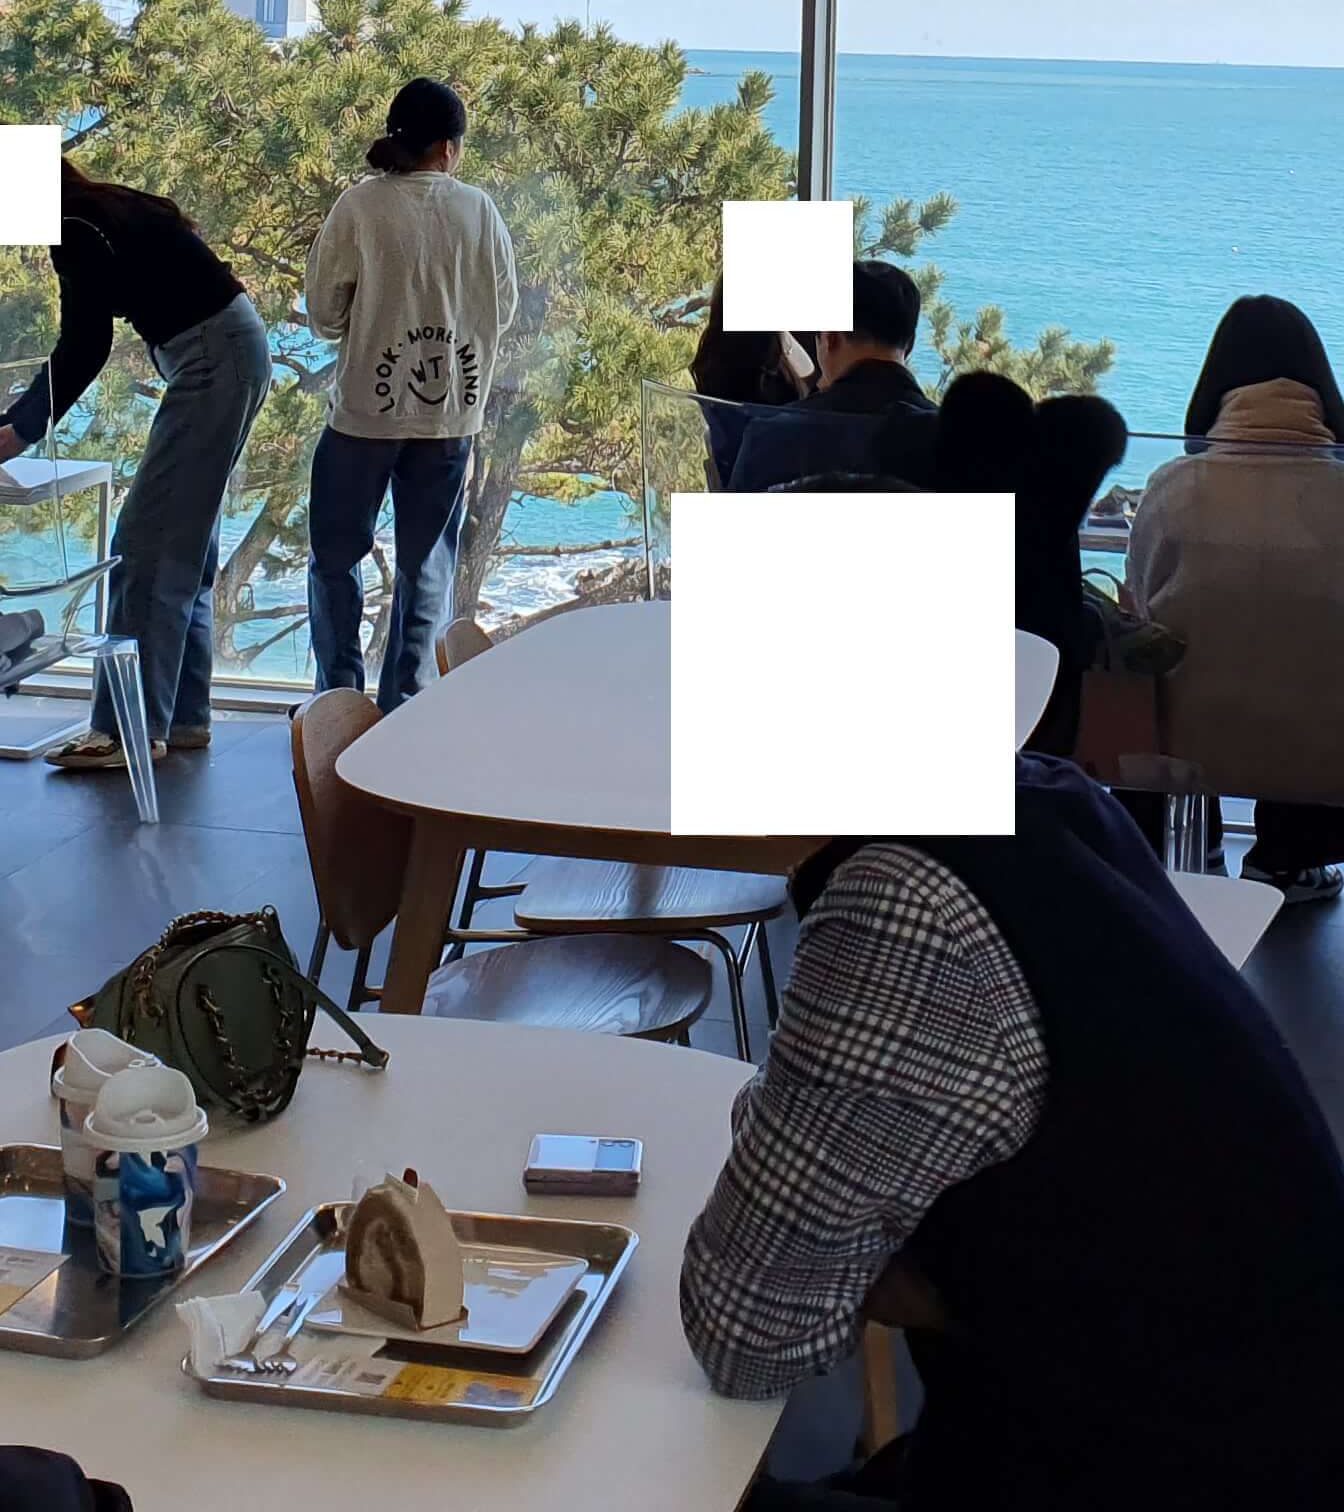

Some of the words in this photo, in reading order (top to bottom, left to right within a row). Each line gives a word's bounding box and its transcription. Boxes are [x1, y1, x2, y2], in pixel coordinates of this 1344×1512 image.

[375, 347, 401, 413] LOOK
[407, 326, 453, 345] MORE
[456, 343, 479, 406] MIND
